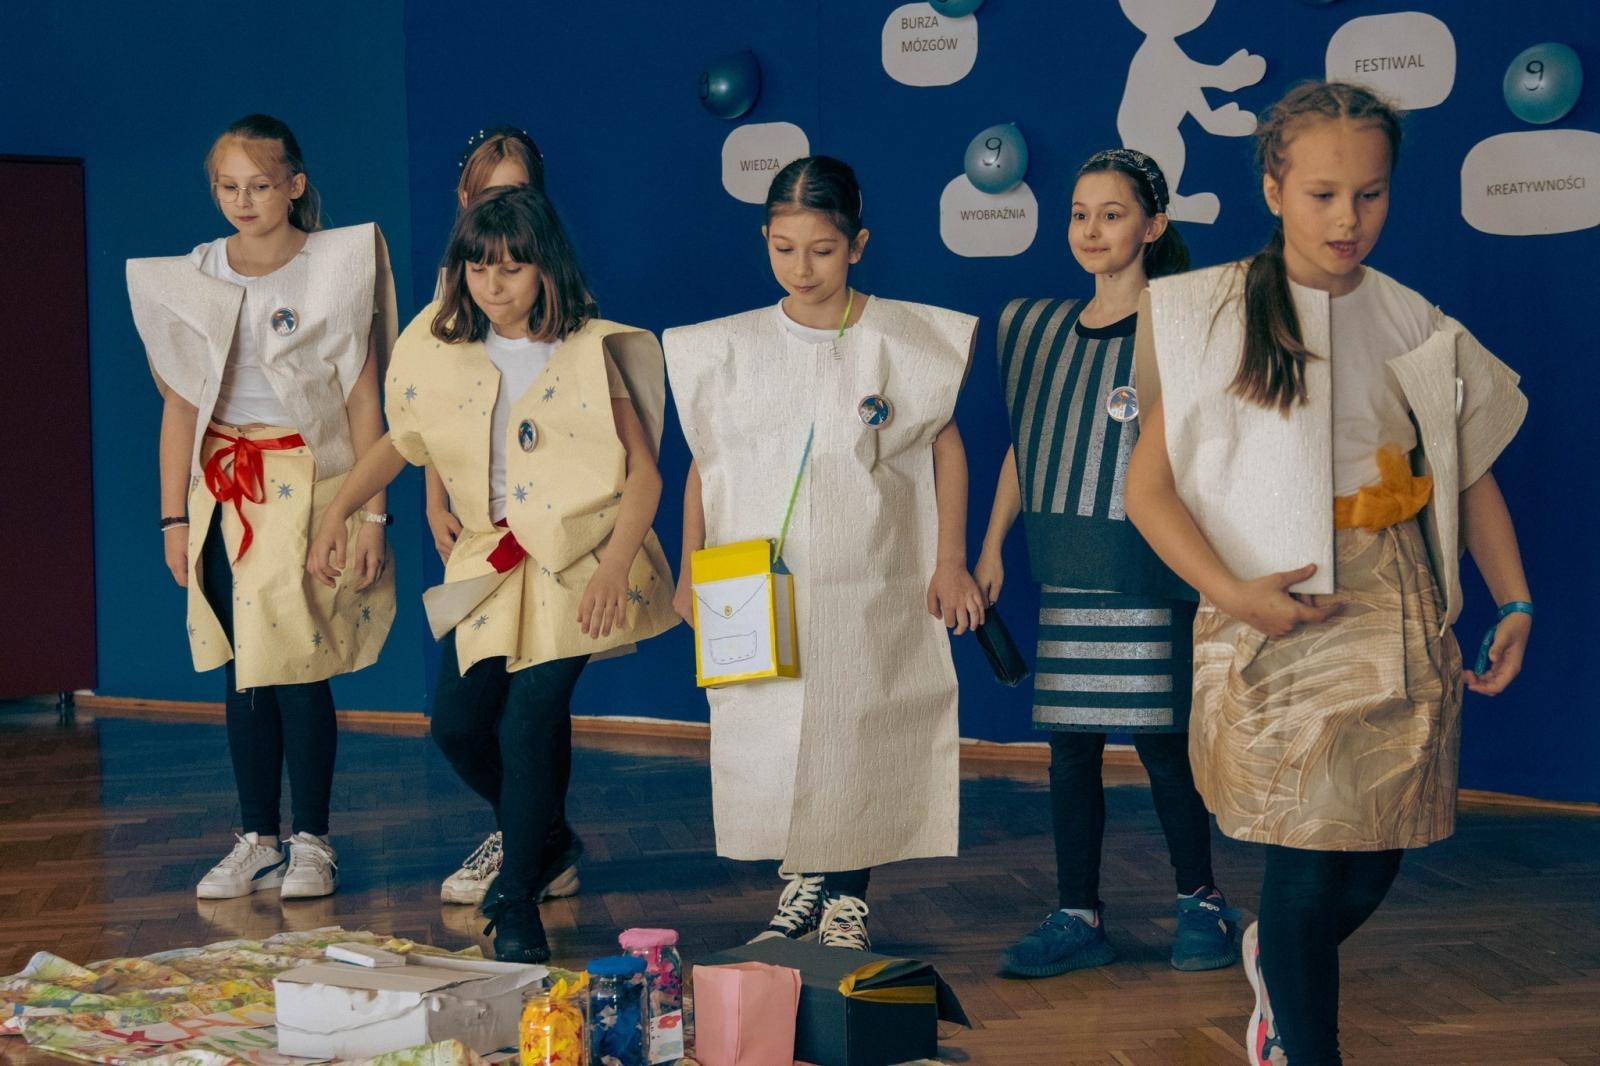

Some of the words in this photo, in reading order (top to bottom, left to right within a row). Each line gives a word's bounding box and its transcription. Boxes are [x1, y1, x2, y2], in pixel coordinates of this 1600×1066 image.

[901, 16, 939, 30] BURZA
[901, 37, 959, 53] MÓZGÓW
[1355, 54, 1425, 73] FESTIWAL
[739, 158, 780, 172] WIEDZA
[1486, 175, 1586, 196] KREATYWNOŚCI
[960, 205, 1026, 221] WYOBRAŹNIA
